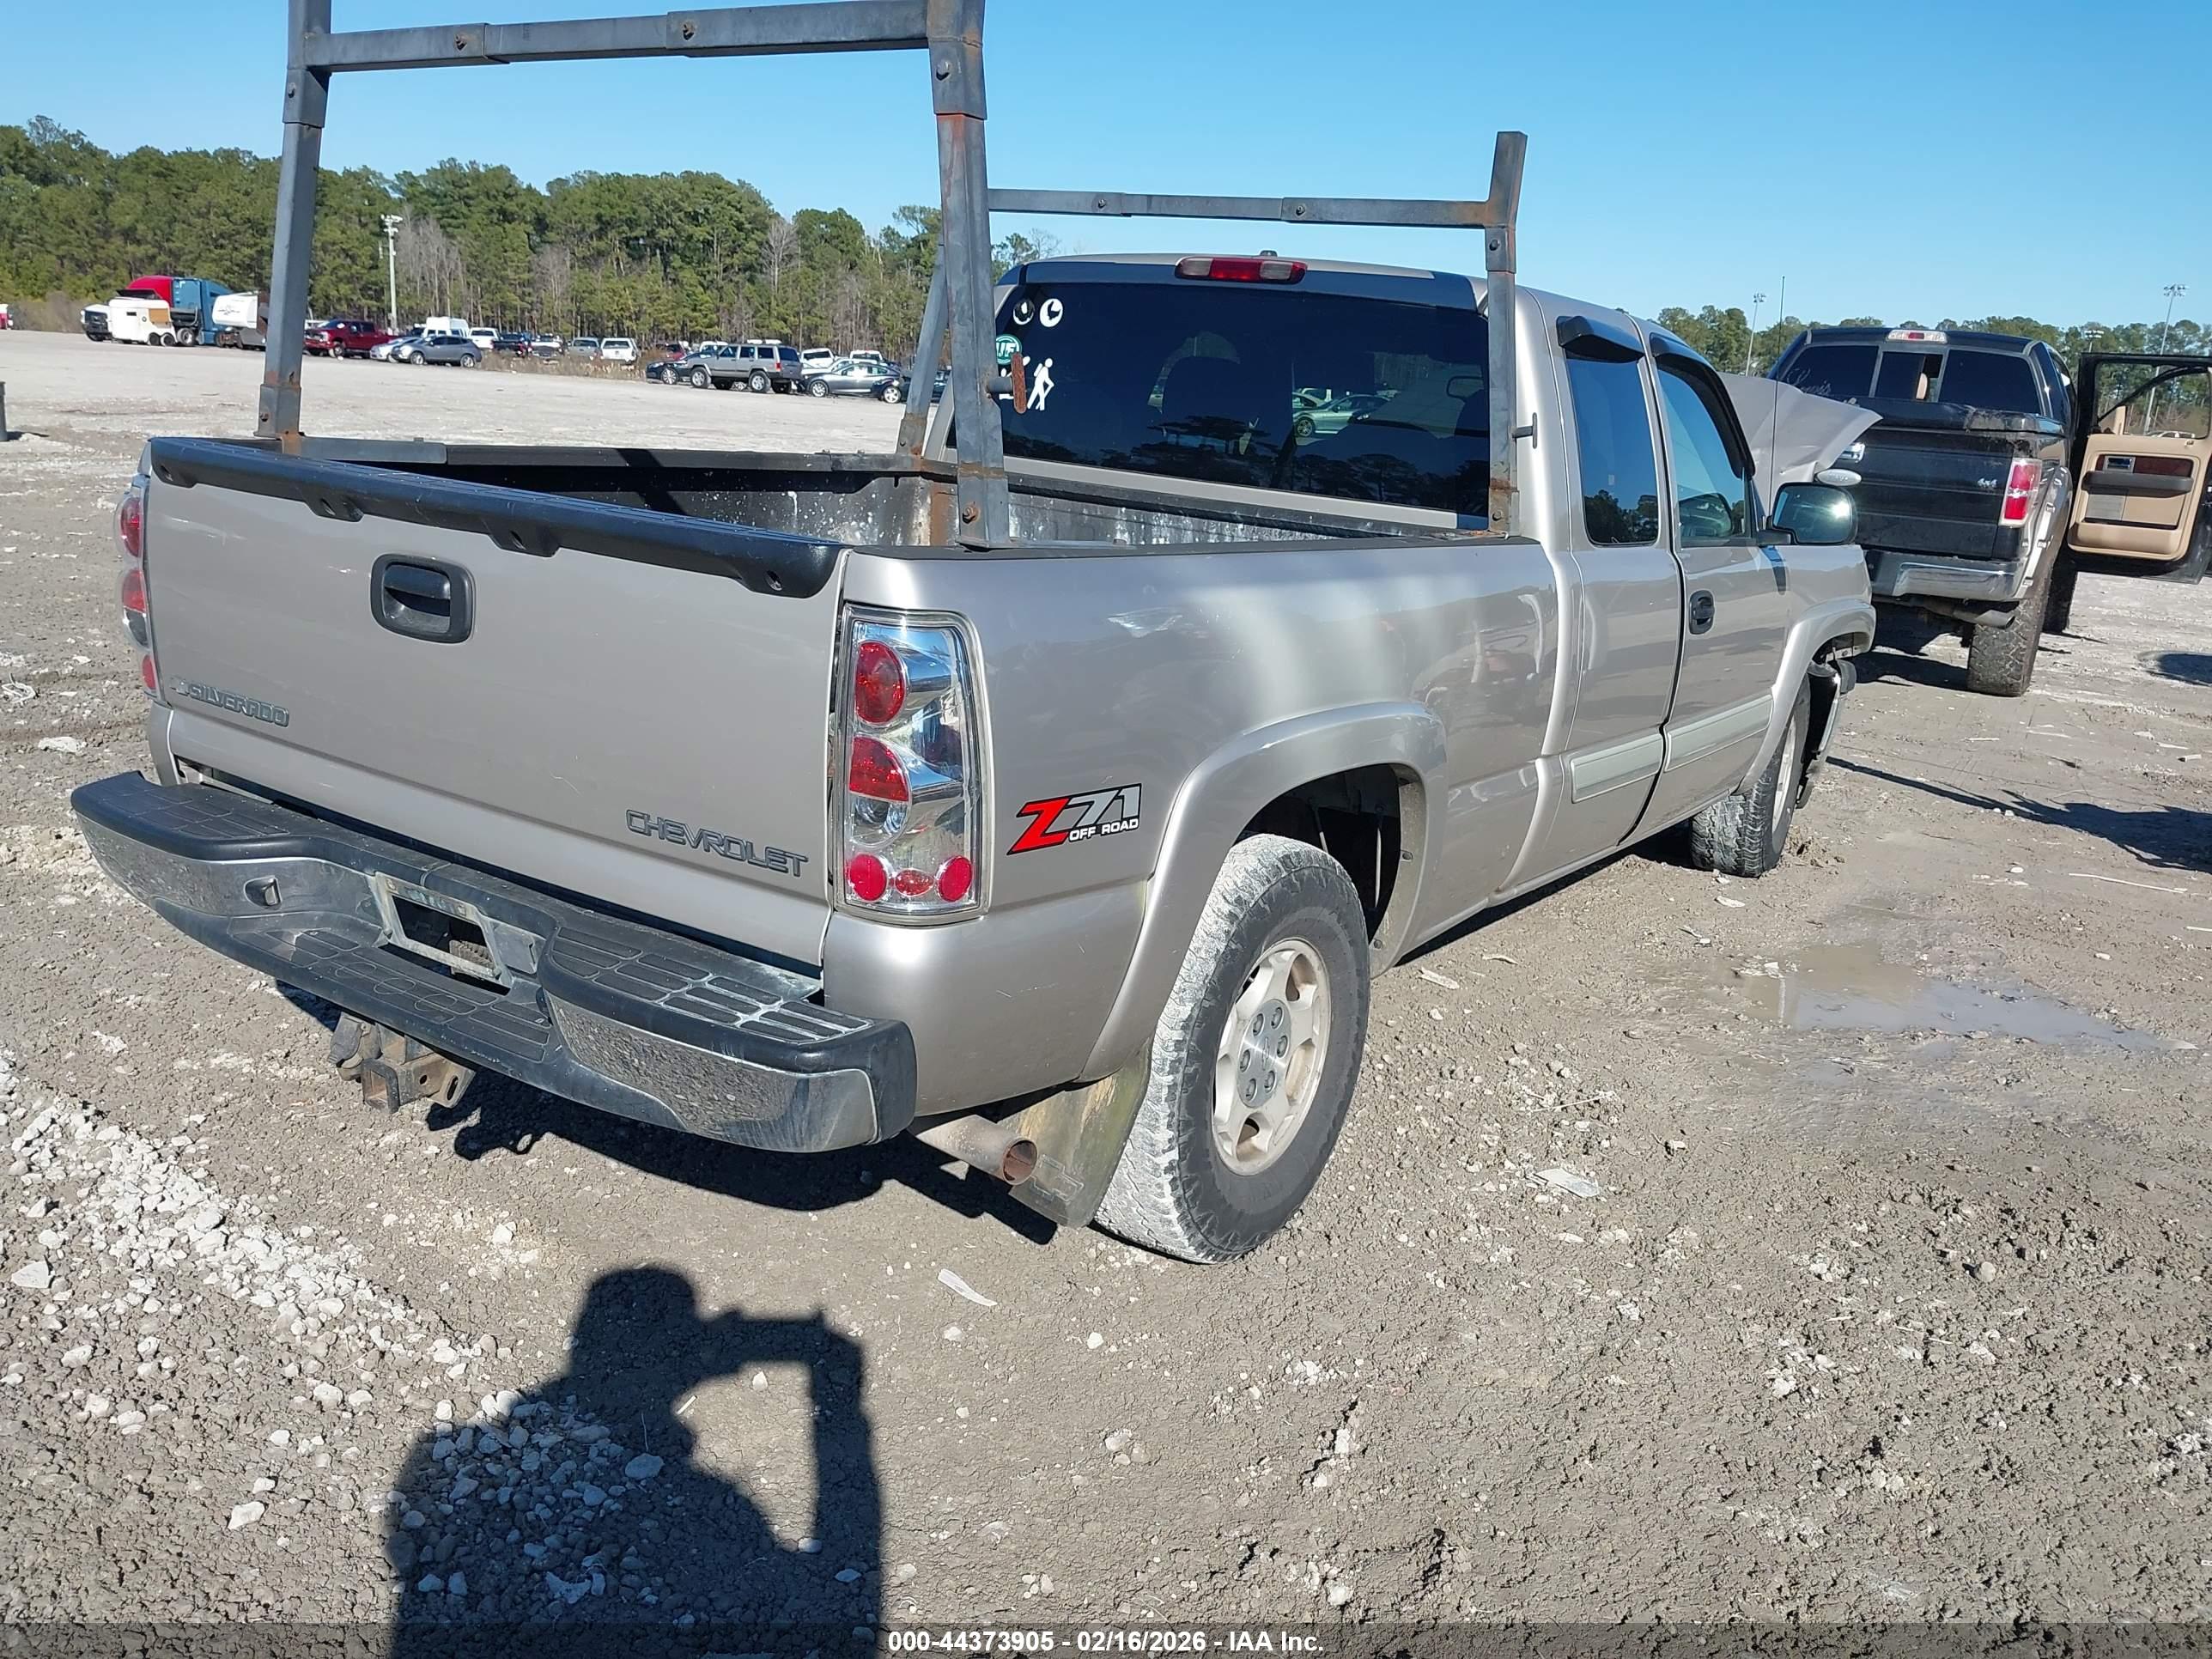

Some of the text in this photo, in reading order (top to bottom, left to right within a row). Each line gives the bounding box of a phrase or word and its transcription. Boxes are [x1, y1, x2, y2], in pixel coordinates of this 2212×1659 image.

[187, 684, 289, 727] SILVERADO
[626, 809, 809, 878] CHEVROLET
[1006, 783, 1141, 855] Z71
[1068, 817, 1139, 842] OFF ROAD
